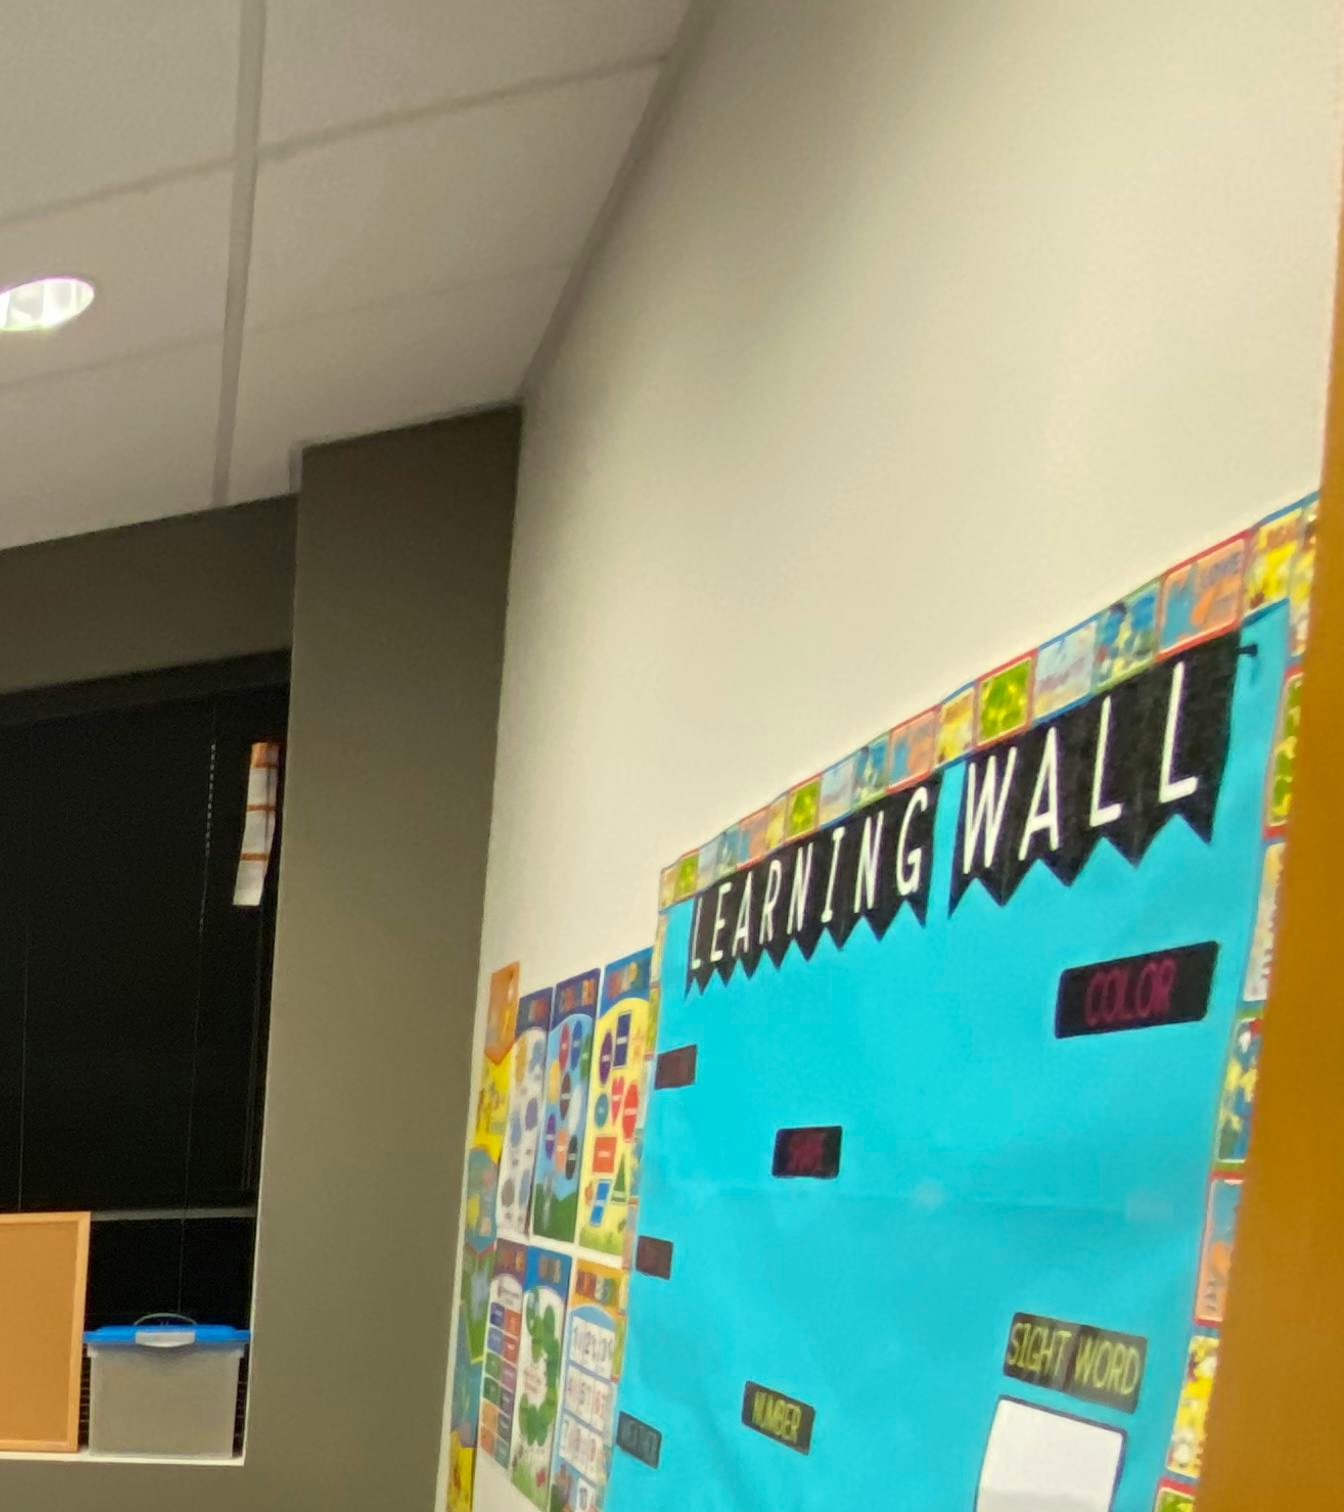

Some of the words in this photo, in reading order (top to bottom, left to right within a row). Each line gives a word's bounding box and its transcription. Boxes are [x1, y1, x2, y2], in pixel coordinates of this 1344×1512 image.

[691, 786, 928, 970] LEARNING
[963, 661, 1199, 875] WALL
[1085, 957, 1177, 1026] COLOR
[1007, 1322, 1072, 1377] SIGHT
[1073, 1336, 1140, 1395] WORD
